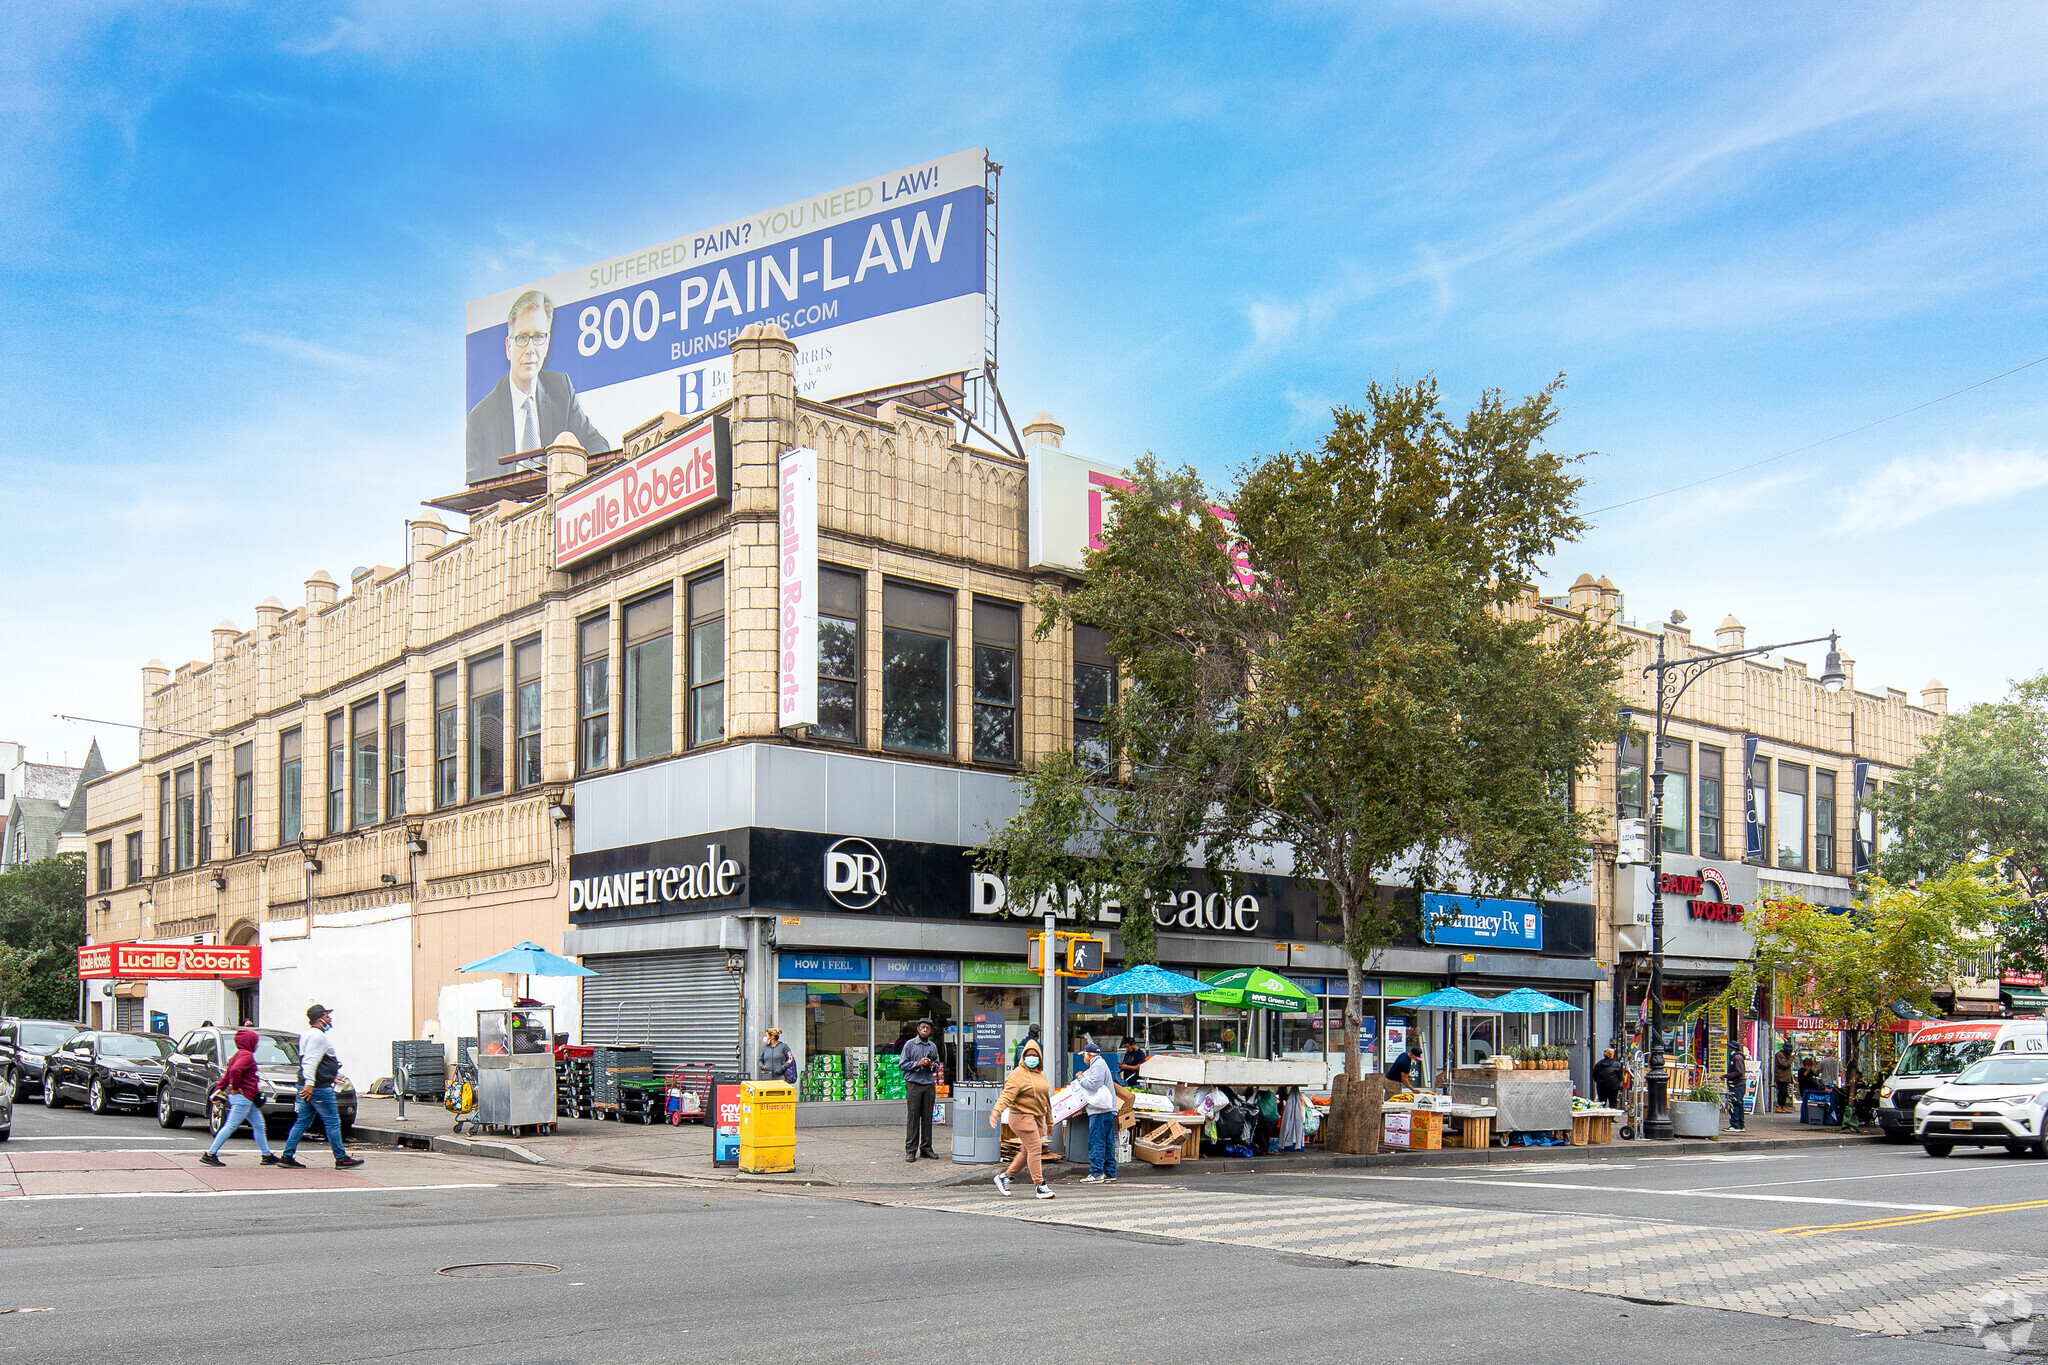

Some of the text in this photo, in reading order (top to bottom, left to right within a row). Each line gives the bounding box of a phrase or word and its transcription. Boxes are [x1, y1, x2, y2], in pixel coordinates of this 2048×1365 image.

[589, 166, 938, 289] SUFFERED PAIN? YOU NEED LAW!
[577, 202, 953, 357] 800-PAIN-LAW
[808, 363, 832, 376] LAW
[804, 380, 817, 391] NY
[556, 446, 714, 555] Lucille Roberts
[782, 463, 802, 714] Lucille Roberts
[826, 852, 887, 896] DR
[1660, 872, 1705, 896] GAME
[1703, 868, 1730, 901] FORDHAM
[1692, 899, 1745, 923] WORLD
[1502, 910, 1520, 935] Rx
[119, 949, 250, 969] Lucille Roberts
[795, 960, 853, 970] HOW I FEEL
[887, 963, 945, 973] HOW I LOOK
[974, 965, 999, 974] WHAT
[1251, 994, 1267, 1002] NYC
[1267, 995, 1285, 1004] Green
[1286, 998, 1299, 1007] Cart
[158, 1021, 164, 1030] P
[1916, 1031, 1992, 1043] COVID-19 TESTING
[2026, 1039, 2043, 1052] CTS
